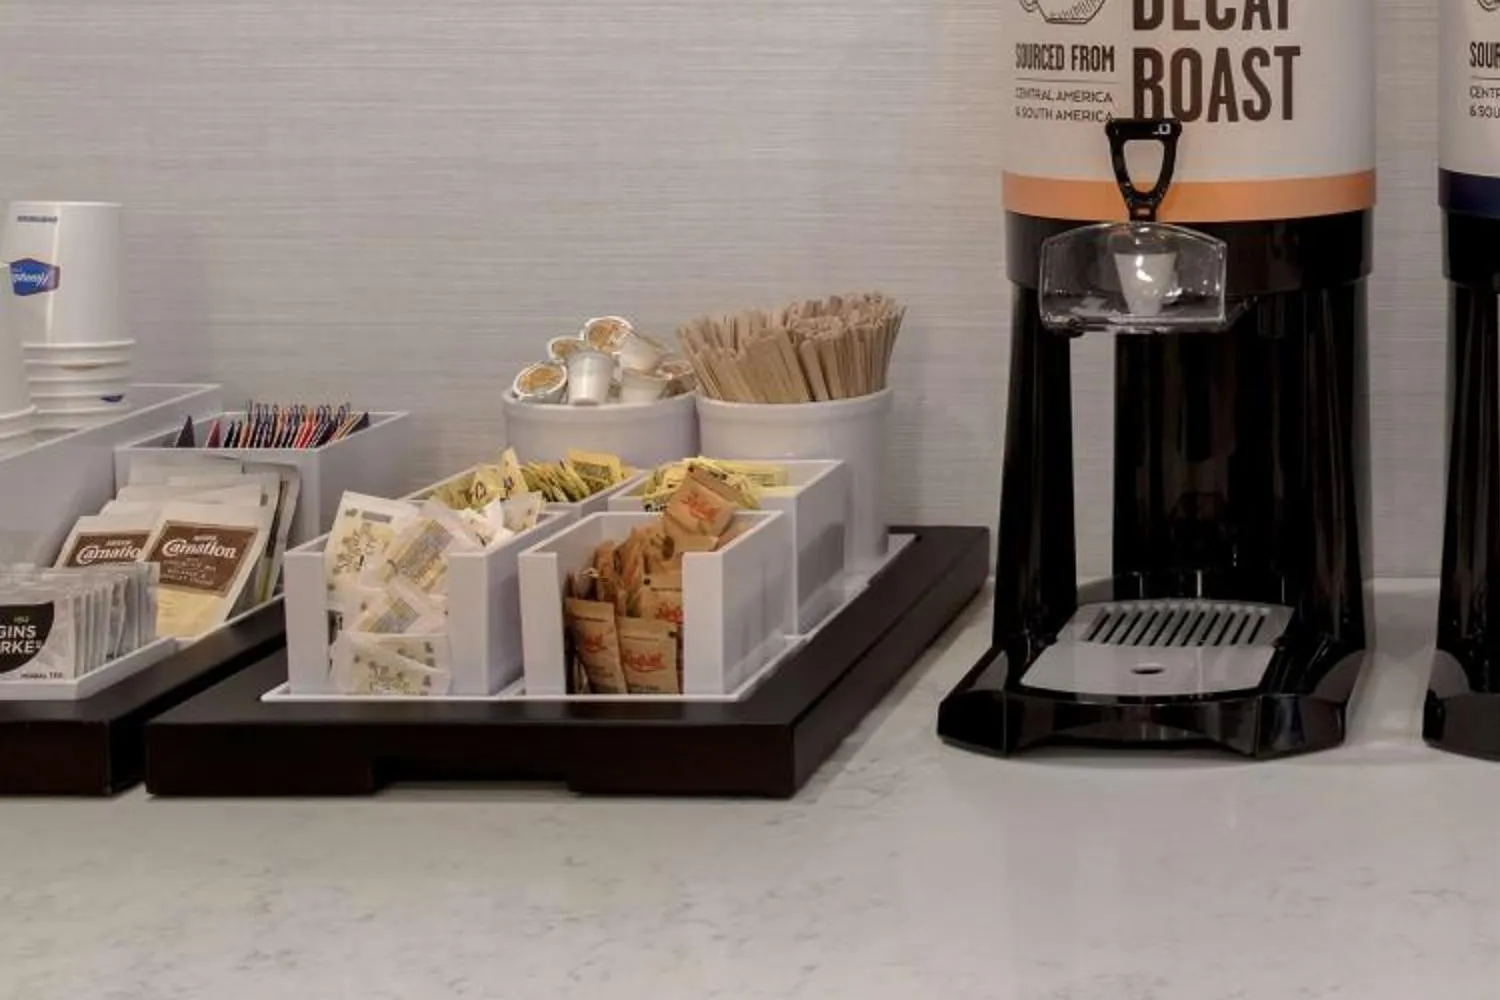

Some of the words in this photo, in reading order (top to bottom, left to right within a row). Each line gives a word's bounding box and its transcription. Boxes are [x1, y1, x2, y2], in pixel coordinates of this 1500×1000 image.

[1015, 43, 1065, 71] SOURCED
[1071, 44, 1115, 72] FROM
[1132, 45, 1301, 123] ROAST
[1056, 90, 1113, 103] AMERICA
[1056, 108, 1113, 122] AMERICA
[76, 545, 144, 565] Carnatio
[162, 538, 238, 560] Carnation
